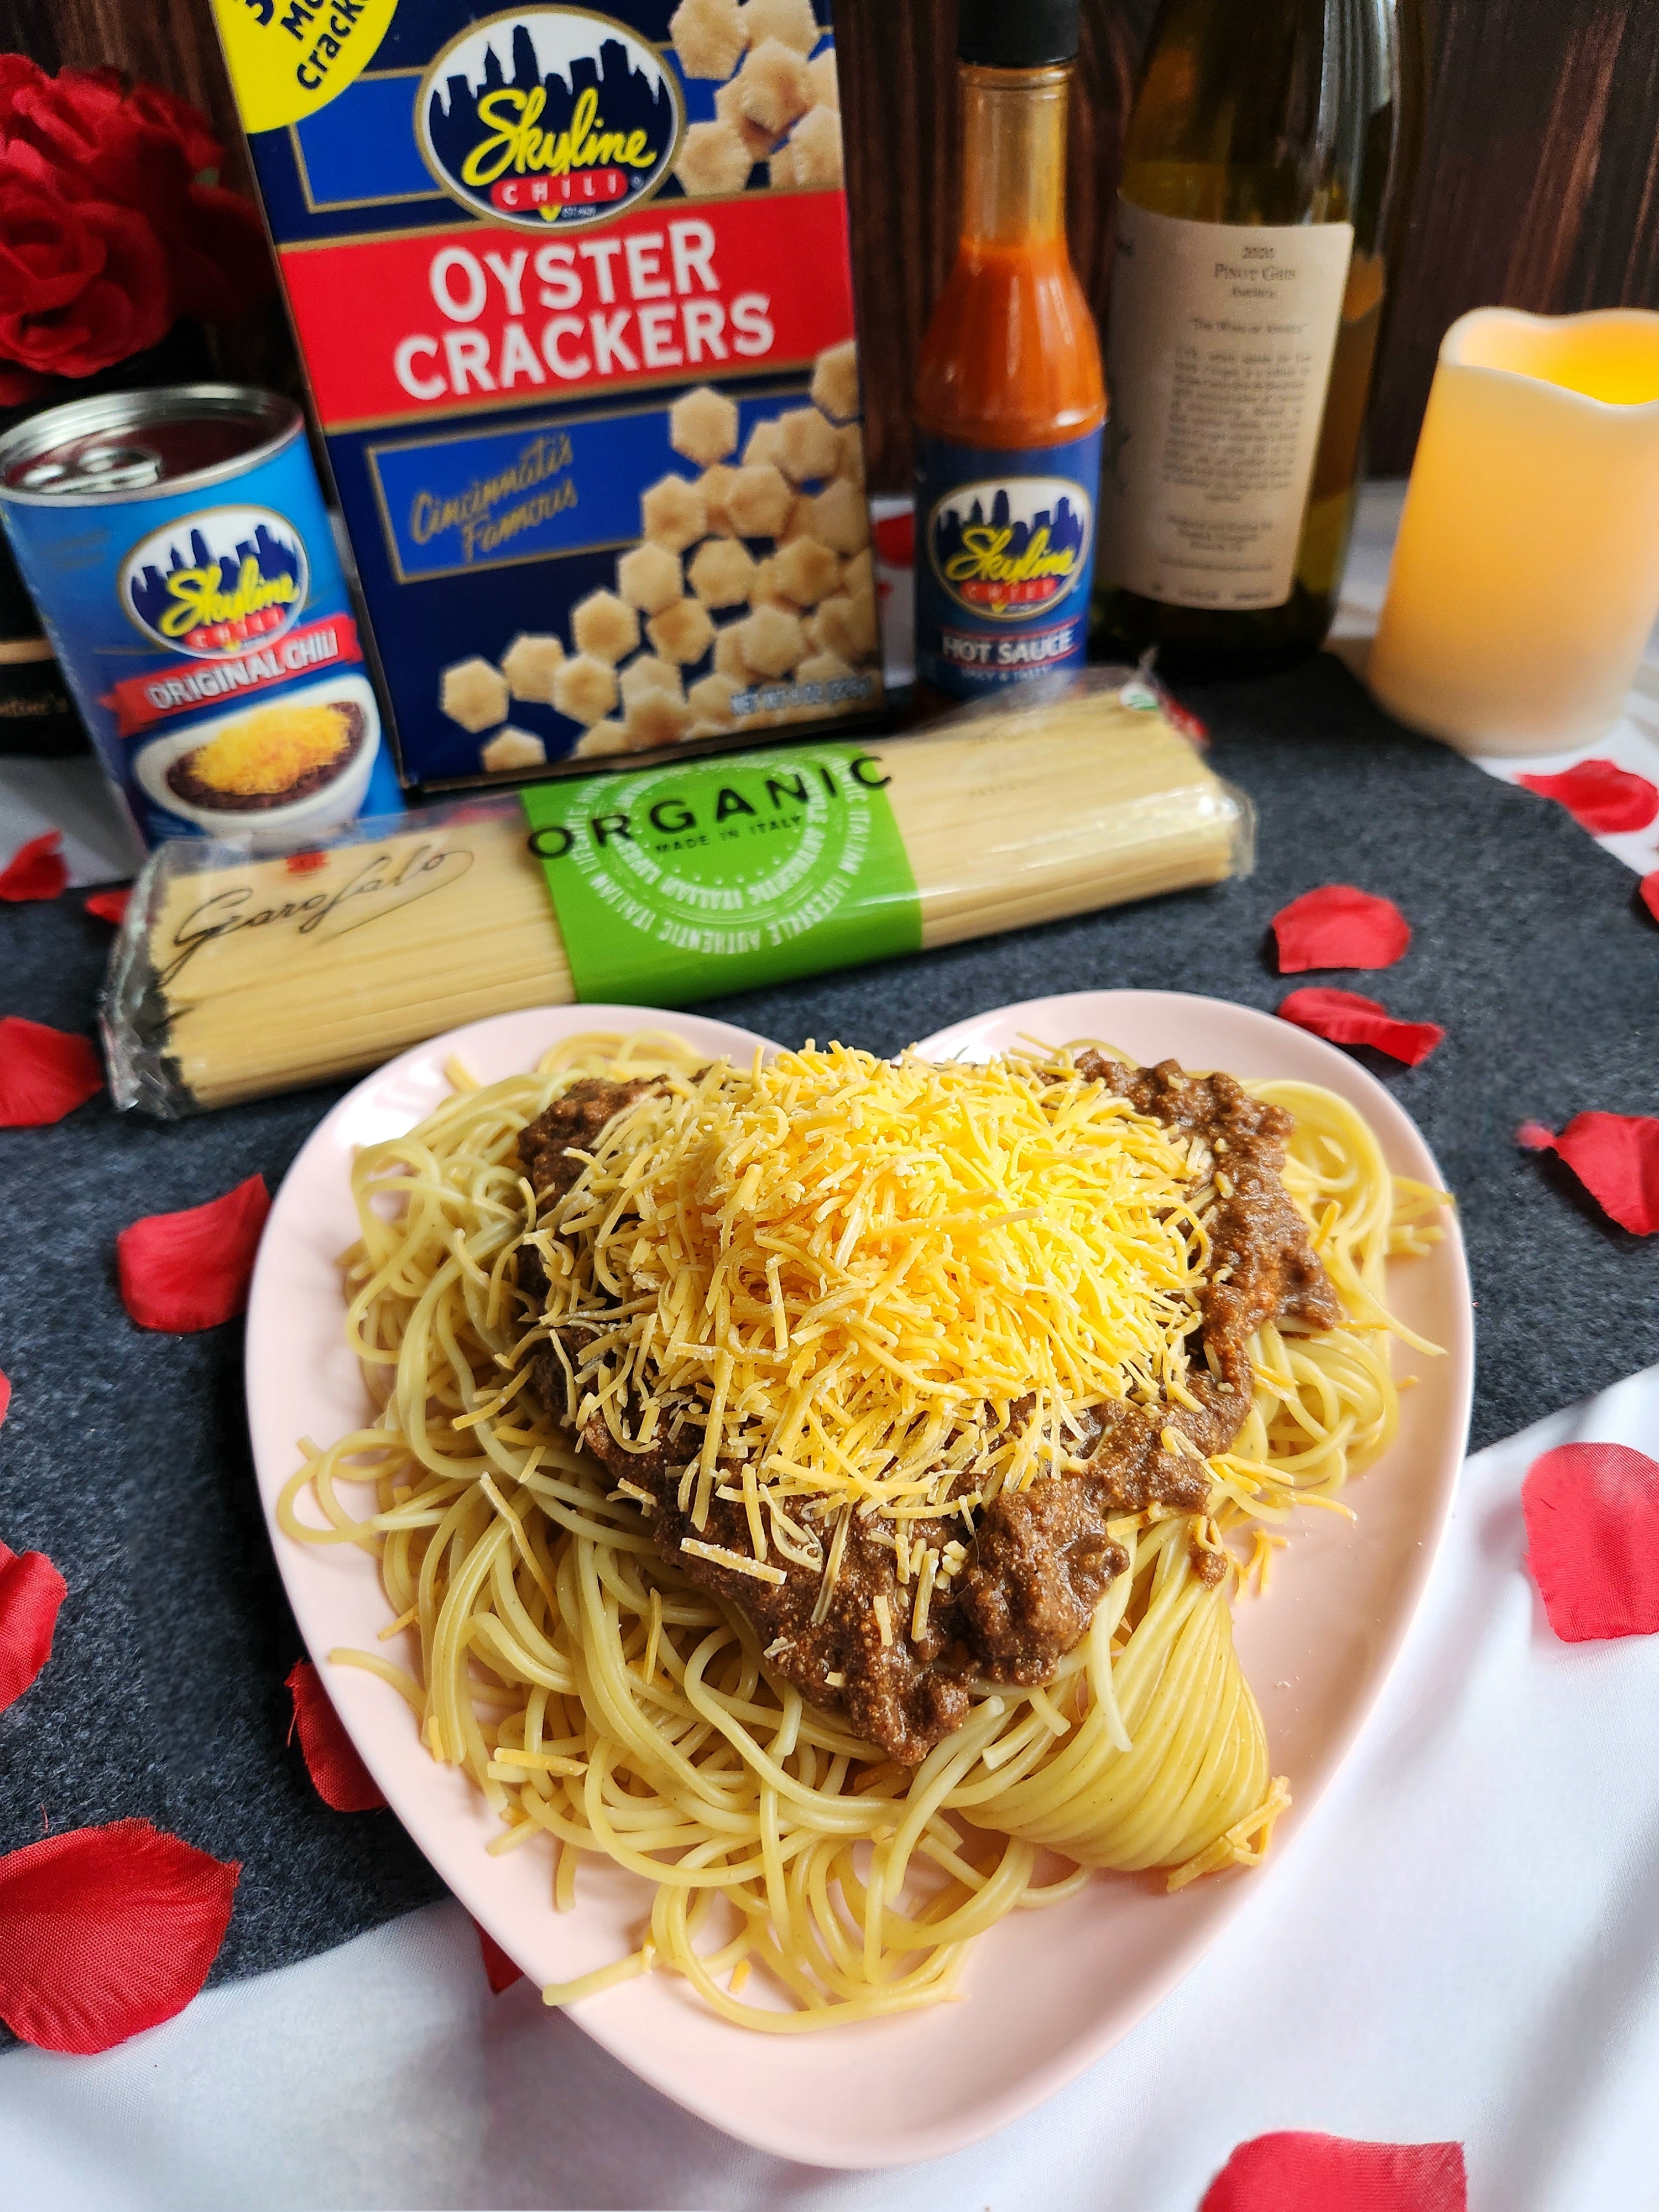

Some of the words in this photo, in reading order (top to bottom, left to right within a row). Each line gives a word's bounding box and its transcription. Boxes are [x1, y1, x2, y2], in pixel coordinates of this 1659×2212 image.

[297, 0, 368, 90] Crack
[462, 86, 657, 186] Skyline
[502, 173, 617, 205] CHILI
[430, 220, 721, 324] OYSTER
[394, 293, 775, 400] CRACKERS
[461, 479, 578, 564] Famous
[944, 525, 1076, 584] Skyline
[158, 557, 300, 637] Skyline
[147, 650, 286, 709] ORIGINAL
[286, 627, 339, 670] CHILI
[942, 635, 992, 662] HOT
[997, 628, 1075, 665] SAUCE
[528, 755, 892, 859] ORGANIC
[655, 835, 710, 853] MADE
[719, 830, 740, 842] IN
[749, 815, 802, 835] ITALY
[156, 844, 474, 991] Garofalo
[589, 872, 658, 933] ITALIAN
[656, 917, 761, 955] AUTHENTIC
